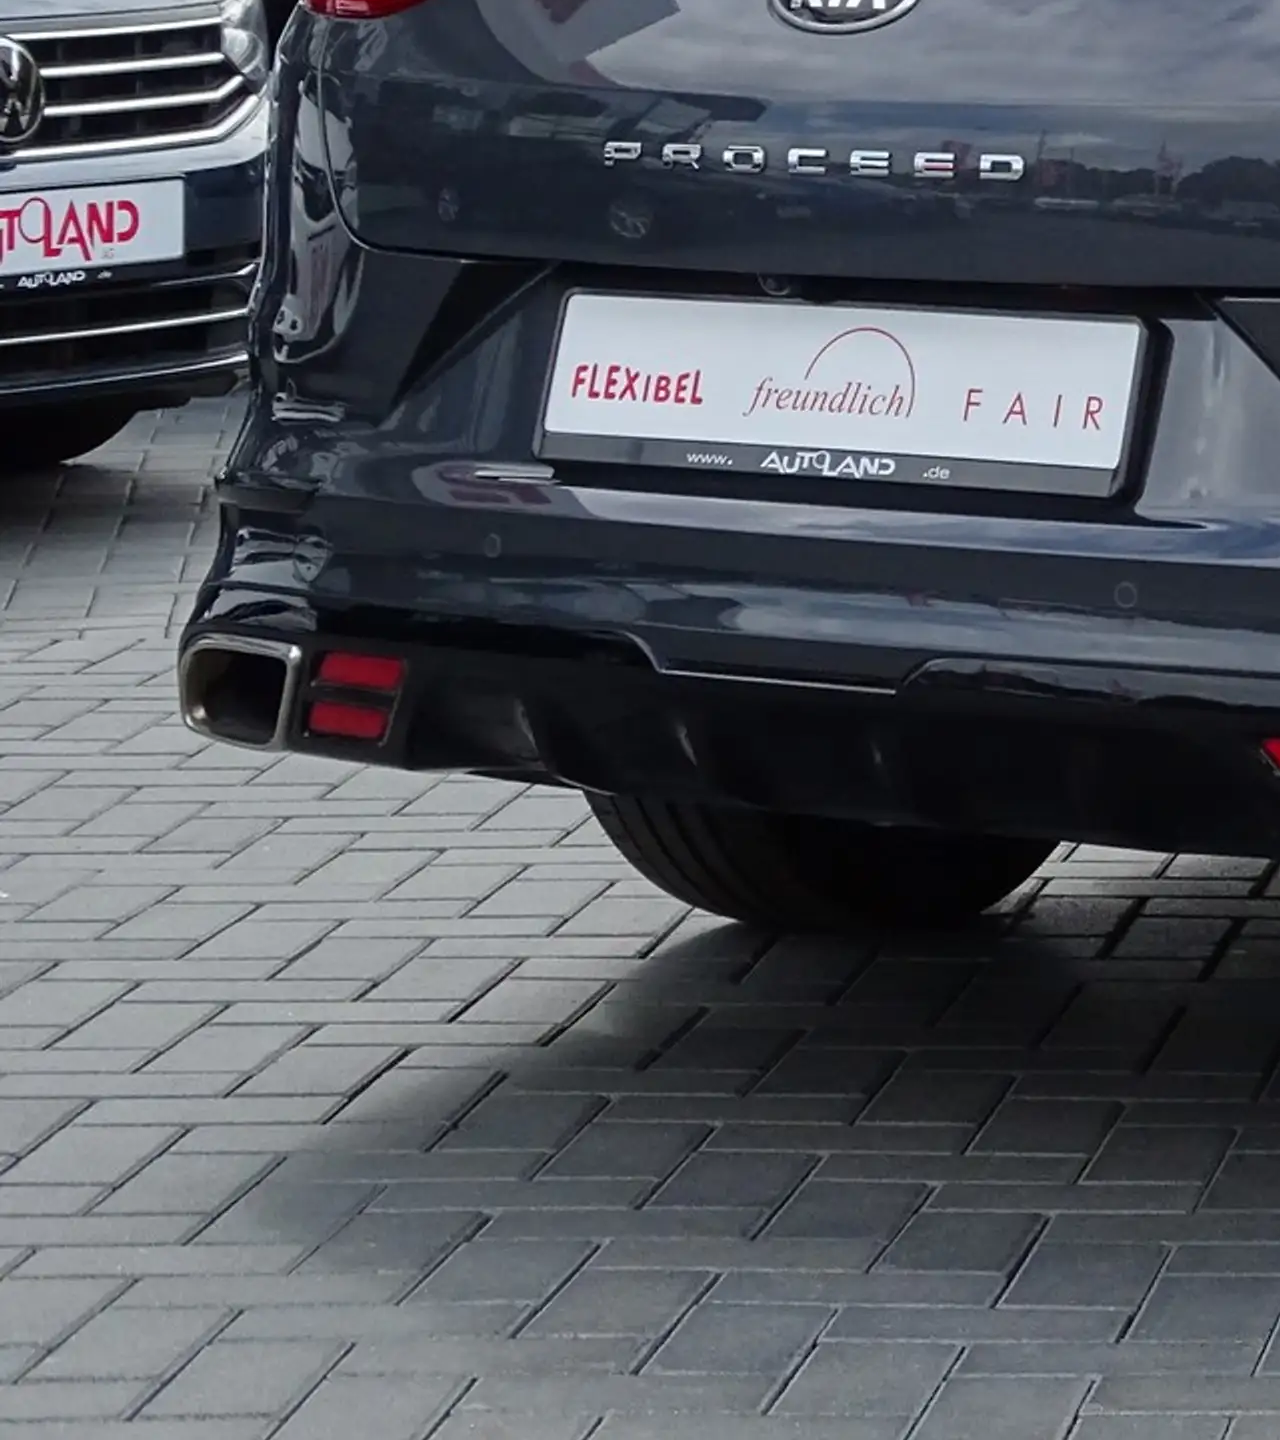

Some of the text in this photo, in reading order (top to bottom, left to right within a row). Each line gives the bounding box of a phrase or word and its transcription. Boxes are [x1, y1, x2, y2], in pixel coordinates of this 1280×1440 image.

[604, 141, 1025, 182] PROCEED
[571, 364, 704, 405] FLEXIBEL
[742, 376, 905, 418] freundlich
[686, 450, 951, 480] www. AUTOLAND .de
